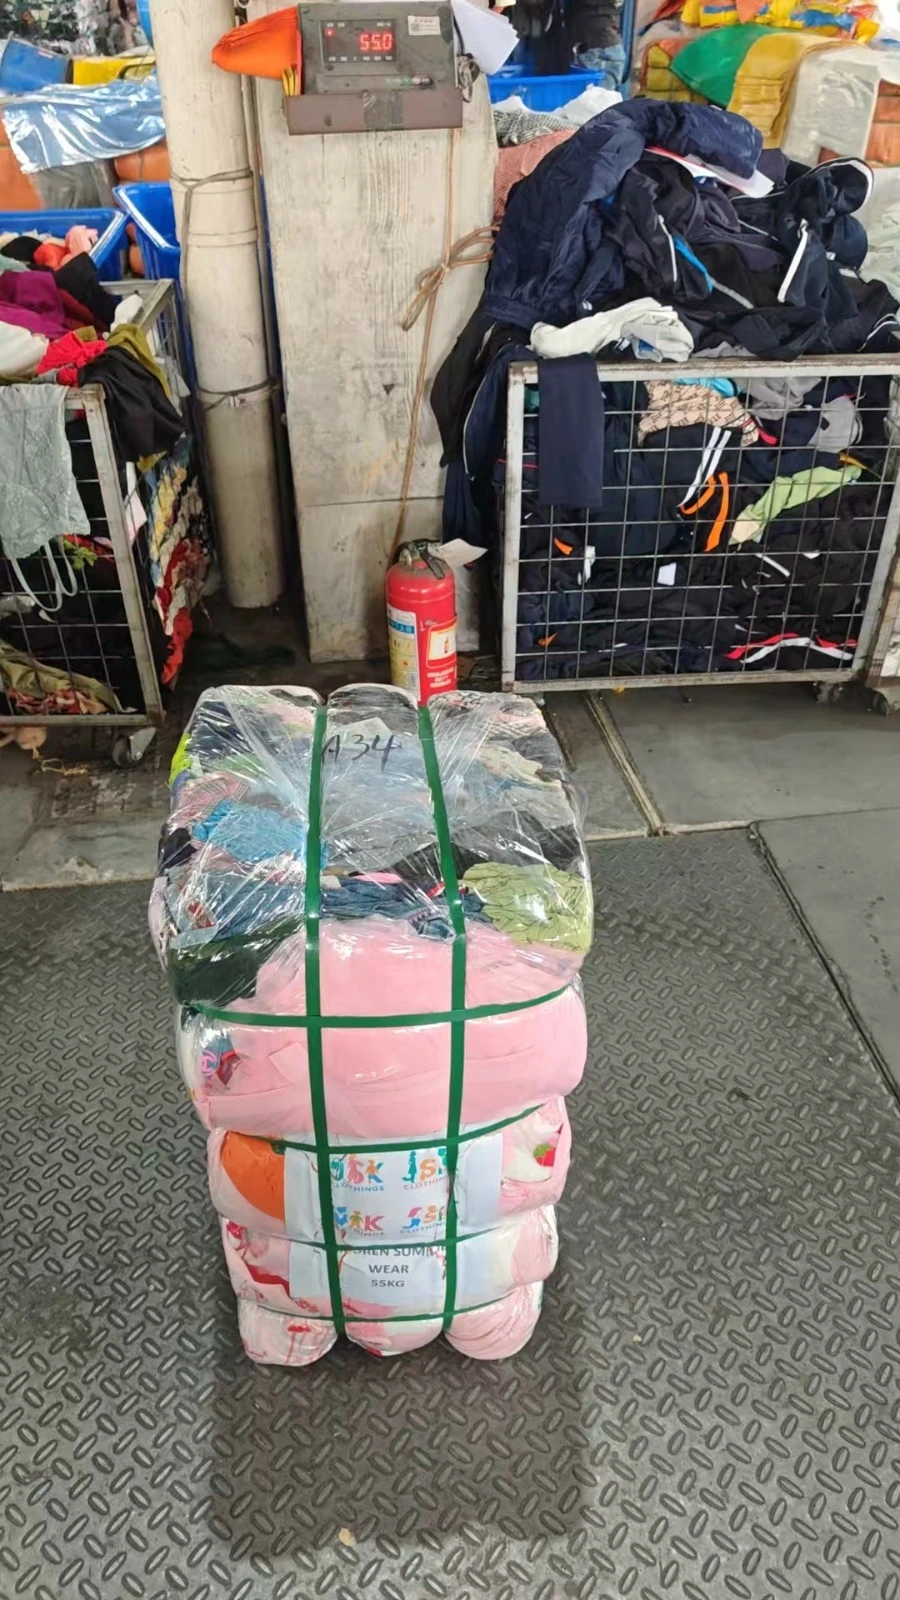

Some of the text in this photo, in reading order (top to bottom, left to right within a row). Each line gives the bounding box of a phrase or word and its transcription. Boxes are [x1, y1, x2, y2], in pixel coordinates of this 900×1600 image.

[321, 734, 402, 771] A34
[403, 1175, 447, 1190] CLOTHIN
[368, 1264, 409, 1274] WEAR
[371, 1279, 405, 1288] 55KG
